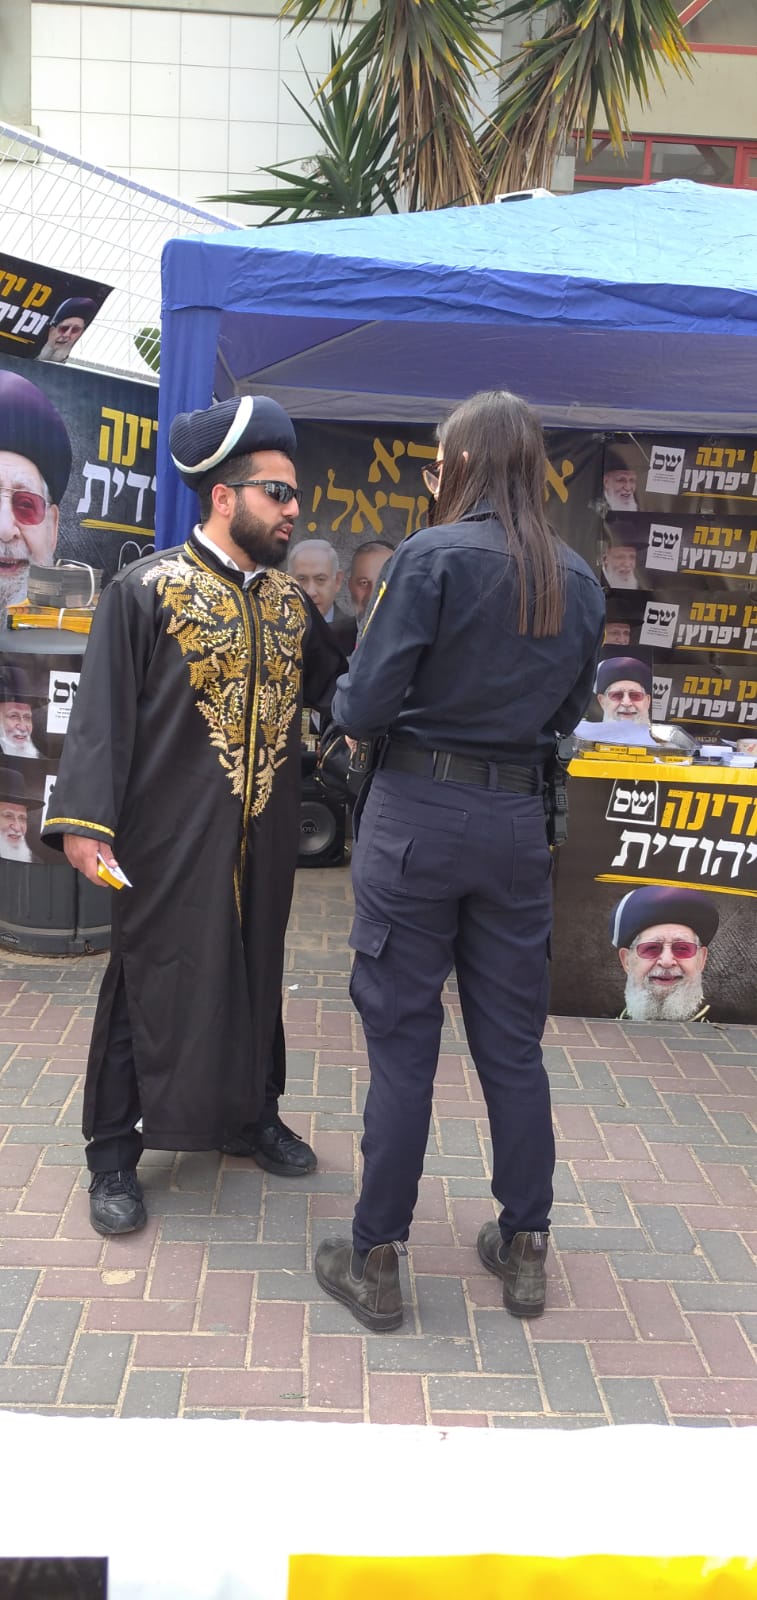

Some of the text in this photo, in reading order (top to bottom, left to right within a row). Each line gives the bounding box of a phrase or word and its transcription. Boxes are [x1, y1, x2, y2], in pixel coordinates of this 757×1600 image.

[22, 282, 52, 308] כן
[11, 308, 50, 336] וכן
[695, 446, 746, 468] ירבה
[682, 469, 750, 492] יפרוץ!
[692, 525, 743, 547] ירבה
[681, 547, 747, 570] יפרוץ!
[689, 602, 737, 622] ירבה
[676, 624, 741, 646] יפרוץ!
[682, 676, 732, 696] ירבה
[670, 697, 736, 718] יפרוץ!
